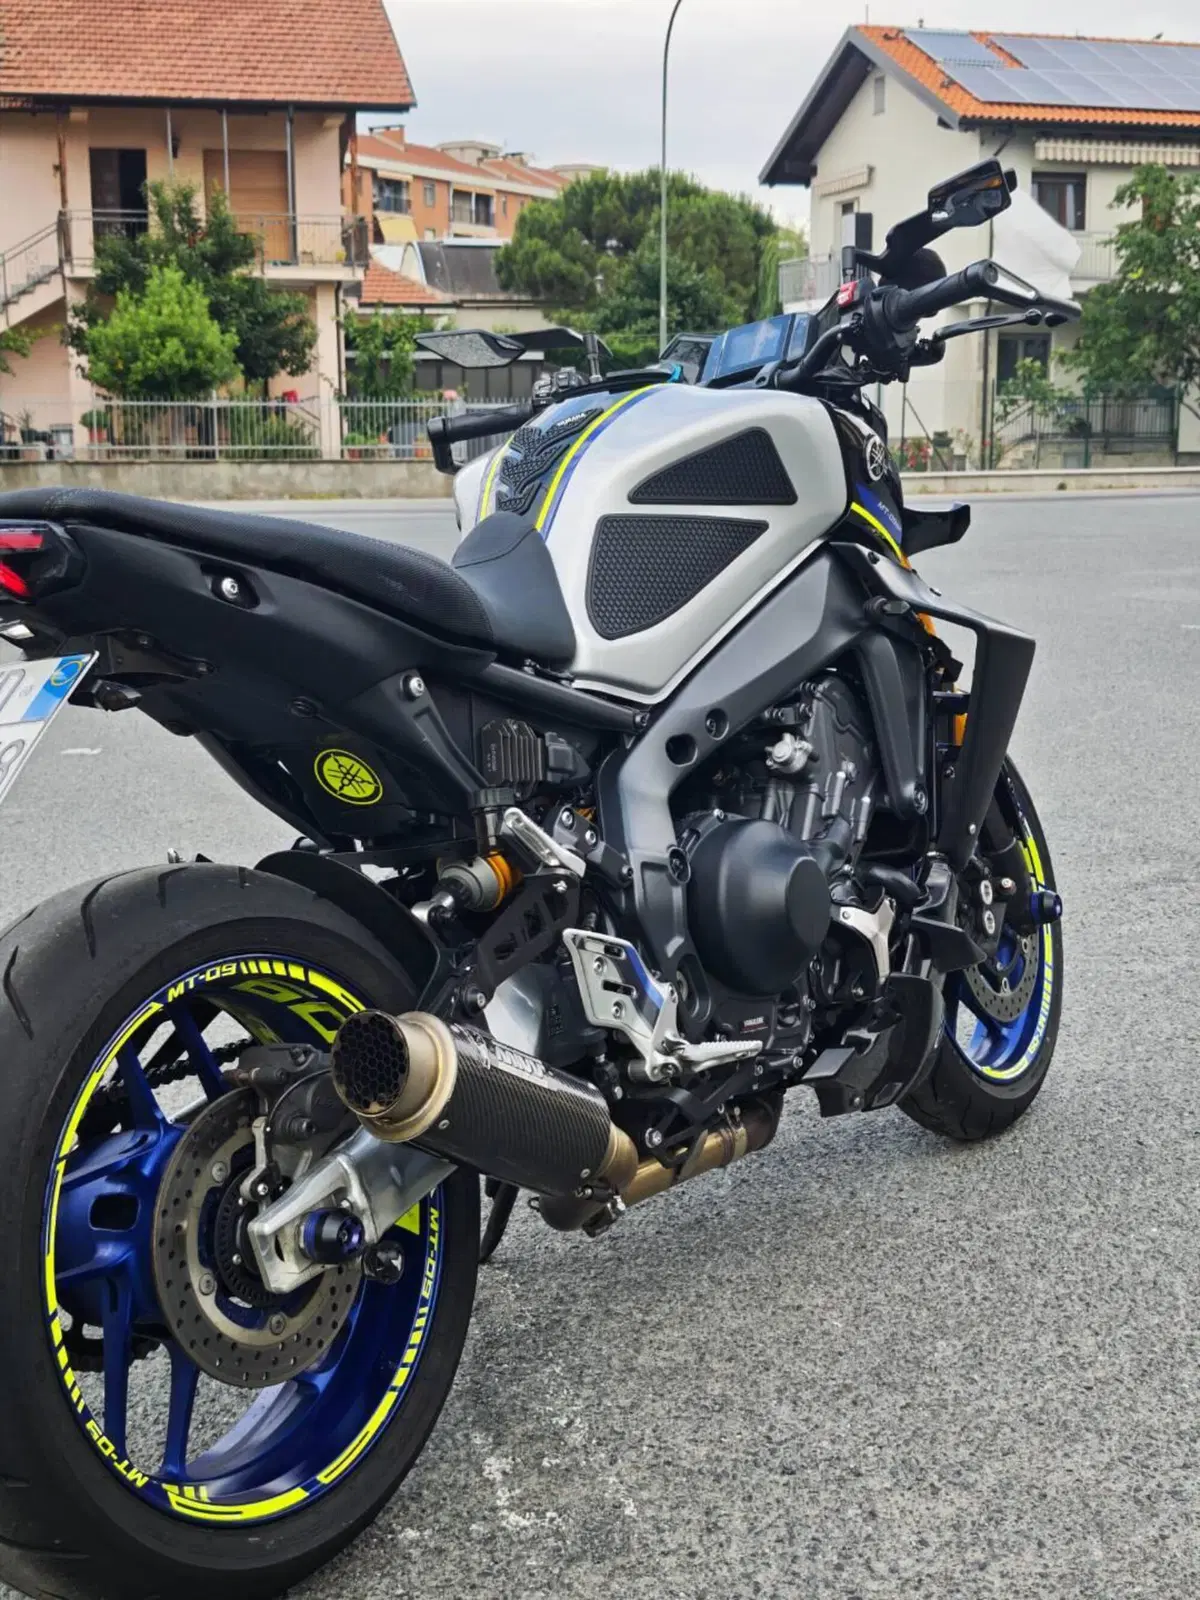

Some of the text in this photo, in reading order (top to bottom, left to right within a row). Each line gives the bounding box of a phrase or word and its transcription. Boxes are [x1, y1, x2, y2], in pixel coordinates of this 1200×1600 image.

[167, 962, 237, 1002] MT-09
[421, 1206, 440, 1300] MT-09
[85, 1420, 149, 1487] MT-09
